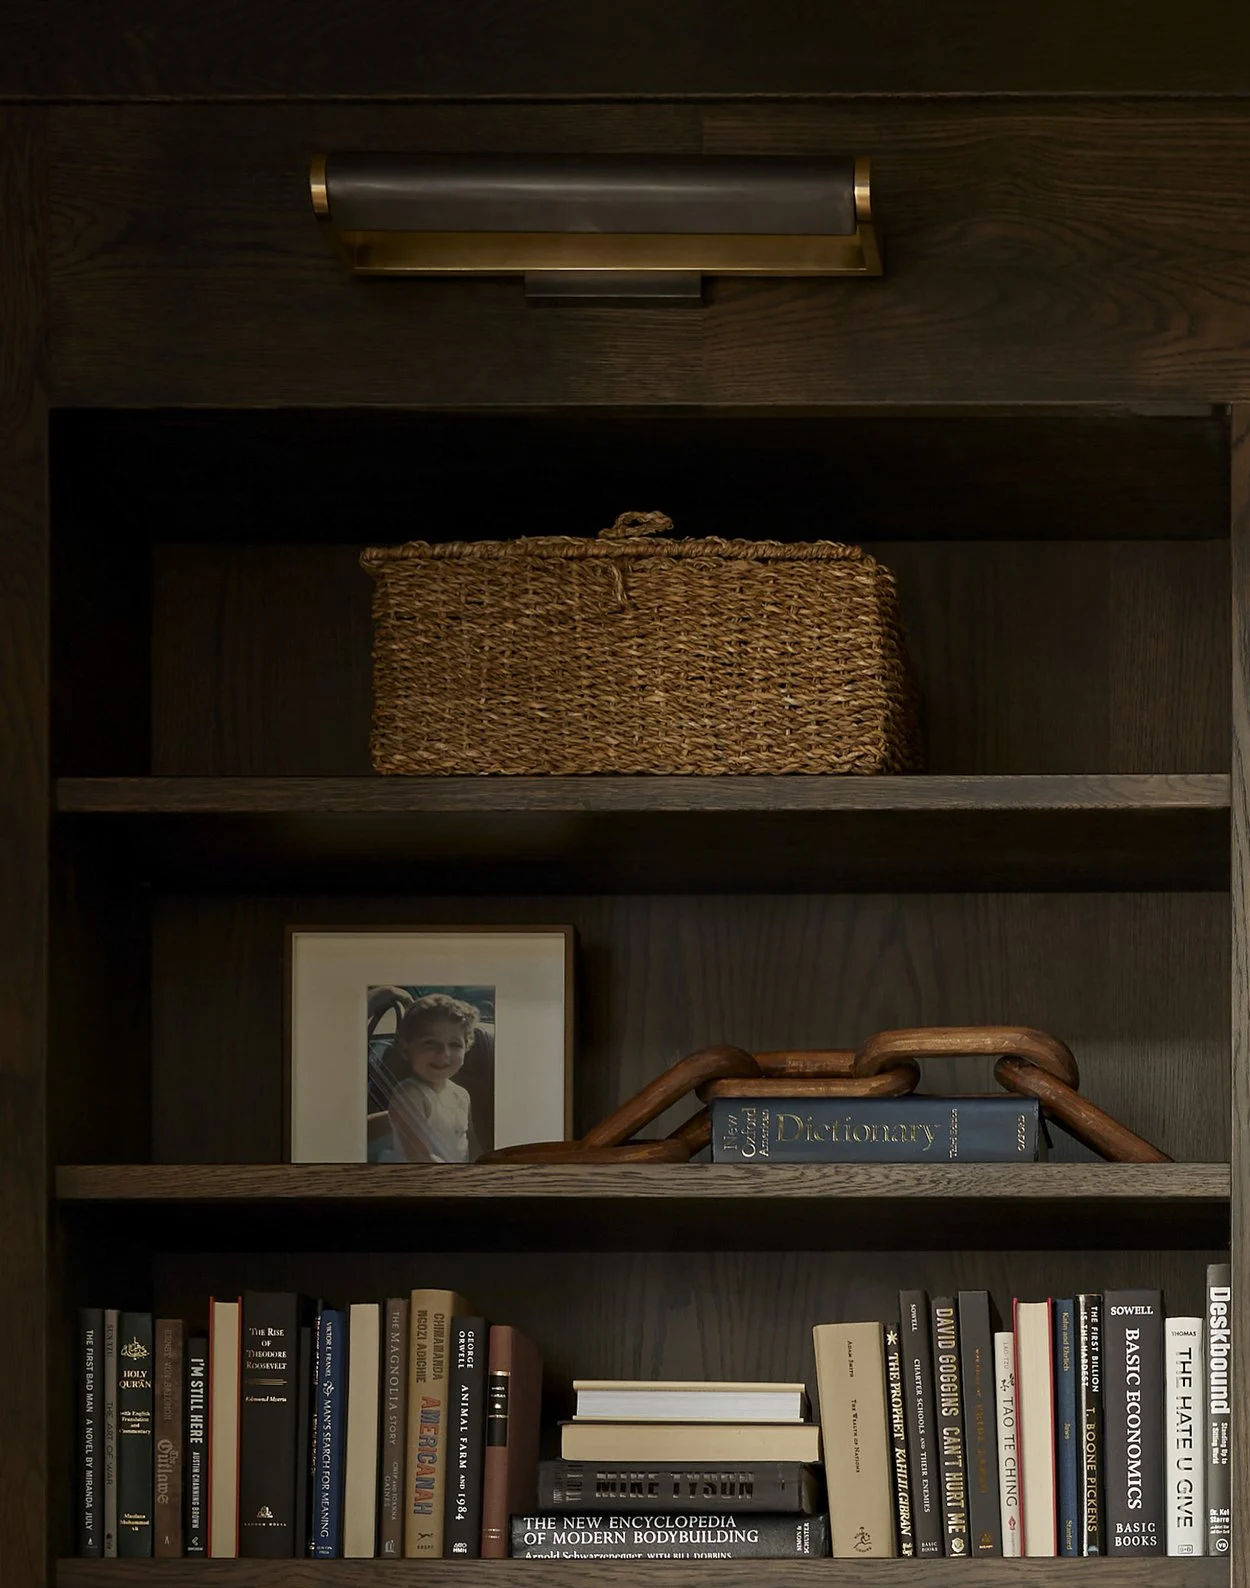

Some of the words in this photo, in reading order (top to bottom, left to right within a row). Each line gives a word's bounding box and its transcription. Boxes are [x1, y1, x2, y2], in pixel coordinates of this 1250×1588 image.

[740, 1106, 758, 1158] Oxford
[775, 1111, 941, 1152] Dictionary
[1091, 1306, 1100, 1323] THE
[1110, 1305, 1154, 1317] SOWELL
[86, 1329, 95, 1346] THE
[935, 1307, 955, 1350] DAVID
[1091, 1326, 1100, 1352] FIRST
[1170, 1329, 1198, 1338] THOMAS
[86, 1347, 95, 1371] FIRST
[457, 1330, 466, 1370] ORWELL
[466, 1330, 475, 1369] GEORGE
[1125, 1327, 1141, 1386] BASIC
[1209, 1286, 1231, 1415] Deskbound
[86, 1373, 95, 1391] BAD
[887, 1352, 900, 1381] THE
[1090, 1355, 1100, 1393] BILLION
[1176, 1346, 1193, 1389] THE
[937, 1354, 960, 1417] GOGGINS
[86, 1392, 94, 1412] MAN
[459, 1384, 470, 1432] ANIMAL
[890, 1383, 905, 1440] PROPHET
[1001, 1396, 1015, 1428] TAO
[1086, 1407, 1096, 1417] T.
[86, 1418, 94, 1427] A
[1176, 1395, 1193, 1450] HATE
[85, 1427, 94, 1455] NOVEL
[413, 1395, 442, 1515] AMERICANAH
[458, 1436, 468, 1469] FARM
[942, 1426, 963, 1467] CAN'T
[1003, 1434, 1016, 1451] TE
[1086, 1423, 1097, 1471] BOONE
[1125, 1390, 1143, 1510] ECONOMICS
[85, 1456, 94, 1469] BY
[1176, 1457, 1193, 1471] U
[84, 1469, 94, 1509] MIRANDA
[458, 1473, 468, 1490] AND
[944, 1472, 965, 1508] HURT
[1003, 1457, 1019, 1508] CHING
[455, 1492, 468, 1522] 1984
[1086, 1476, 1098, 1533] PICKENS
[1176, 1478, 1193, 1528] GIVE
[84, 1510, 94, 1531] JULY
[522, 1516, 557, 1530] THE
[562, 1516, 603, 1530] NEW
[608, 1514, 738, 1530] ENCYCLOPEDIA
[947, 1512, 966, 1534] ME
[1115, 1522, 1157, 1534] BASIC
[522, 1531, 547, 1546] OF
[552, 1531, 627, 1545] MODERN
[633, 1529, 760, 1544] BODYBUILDING
[1113, 1535, 1158, 1548] BOOKS
